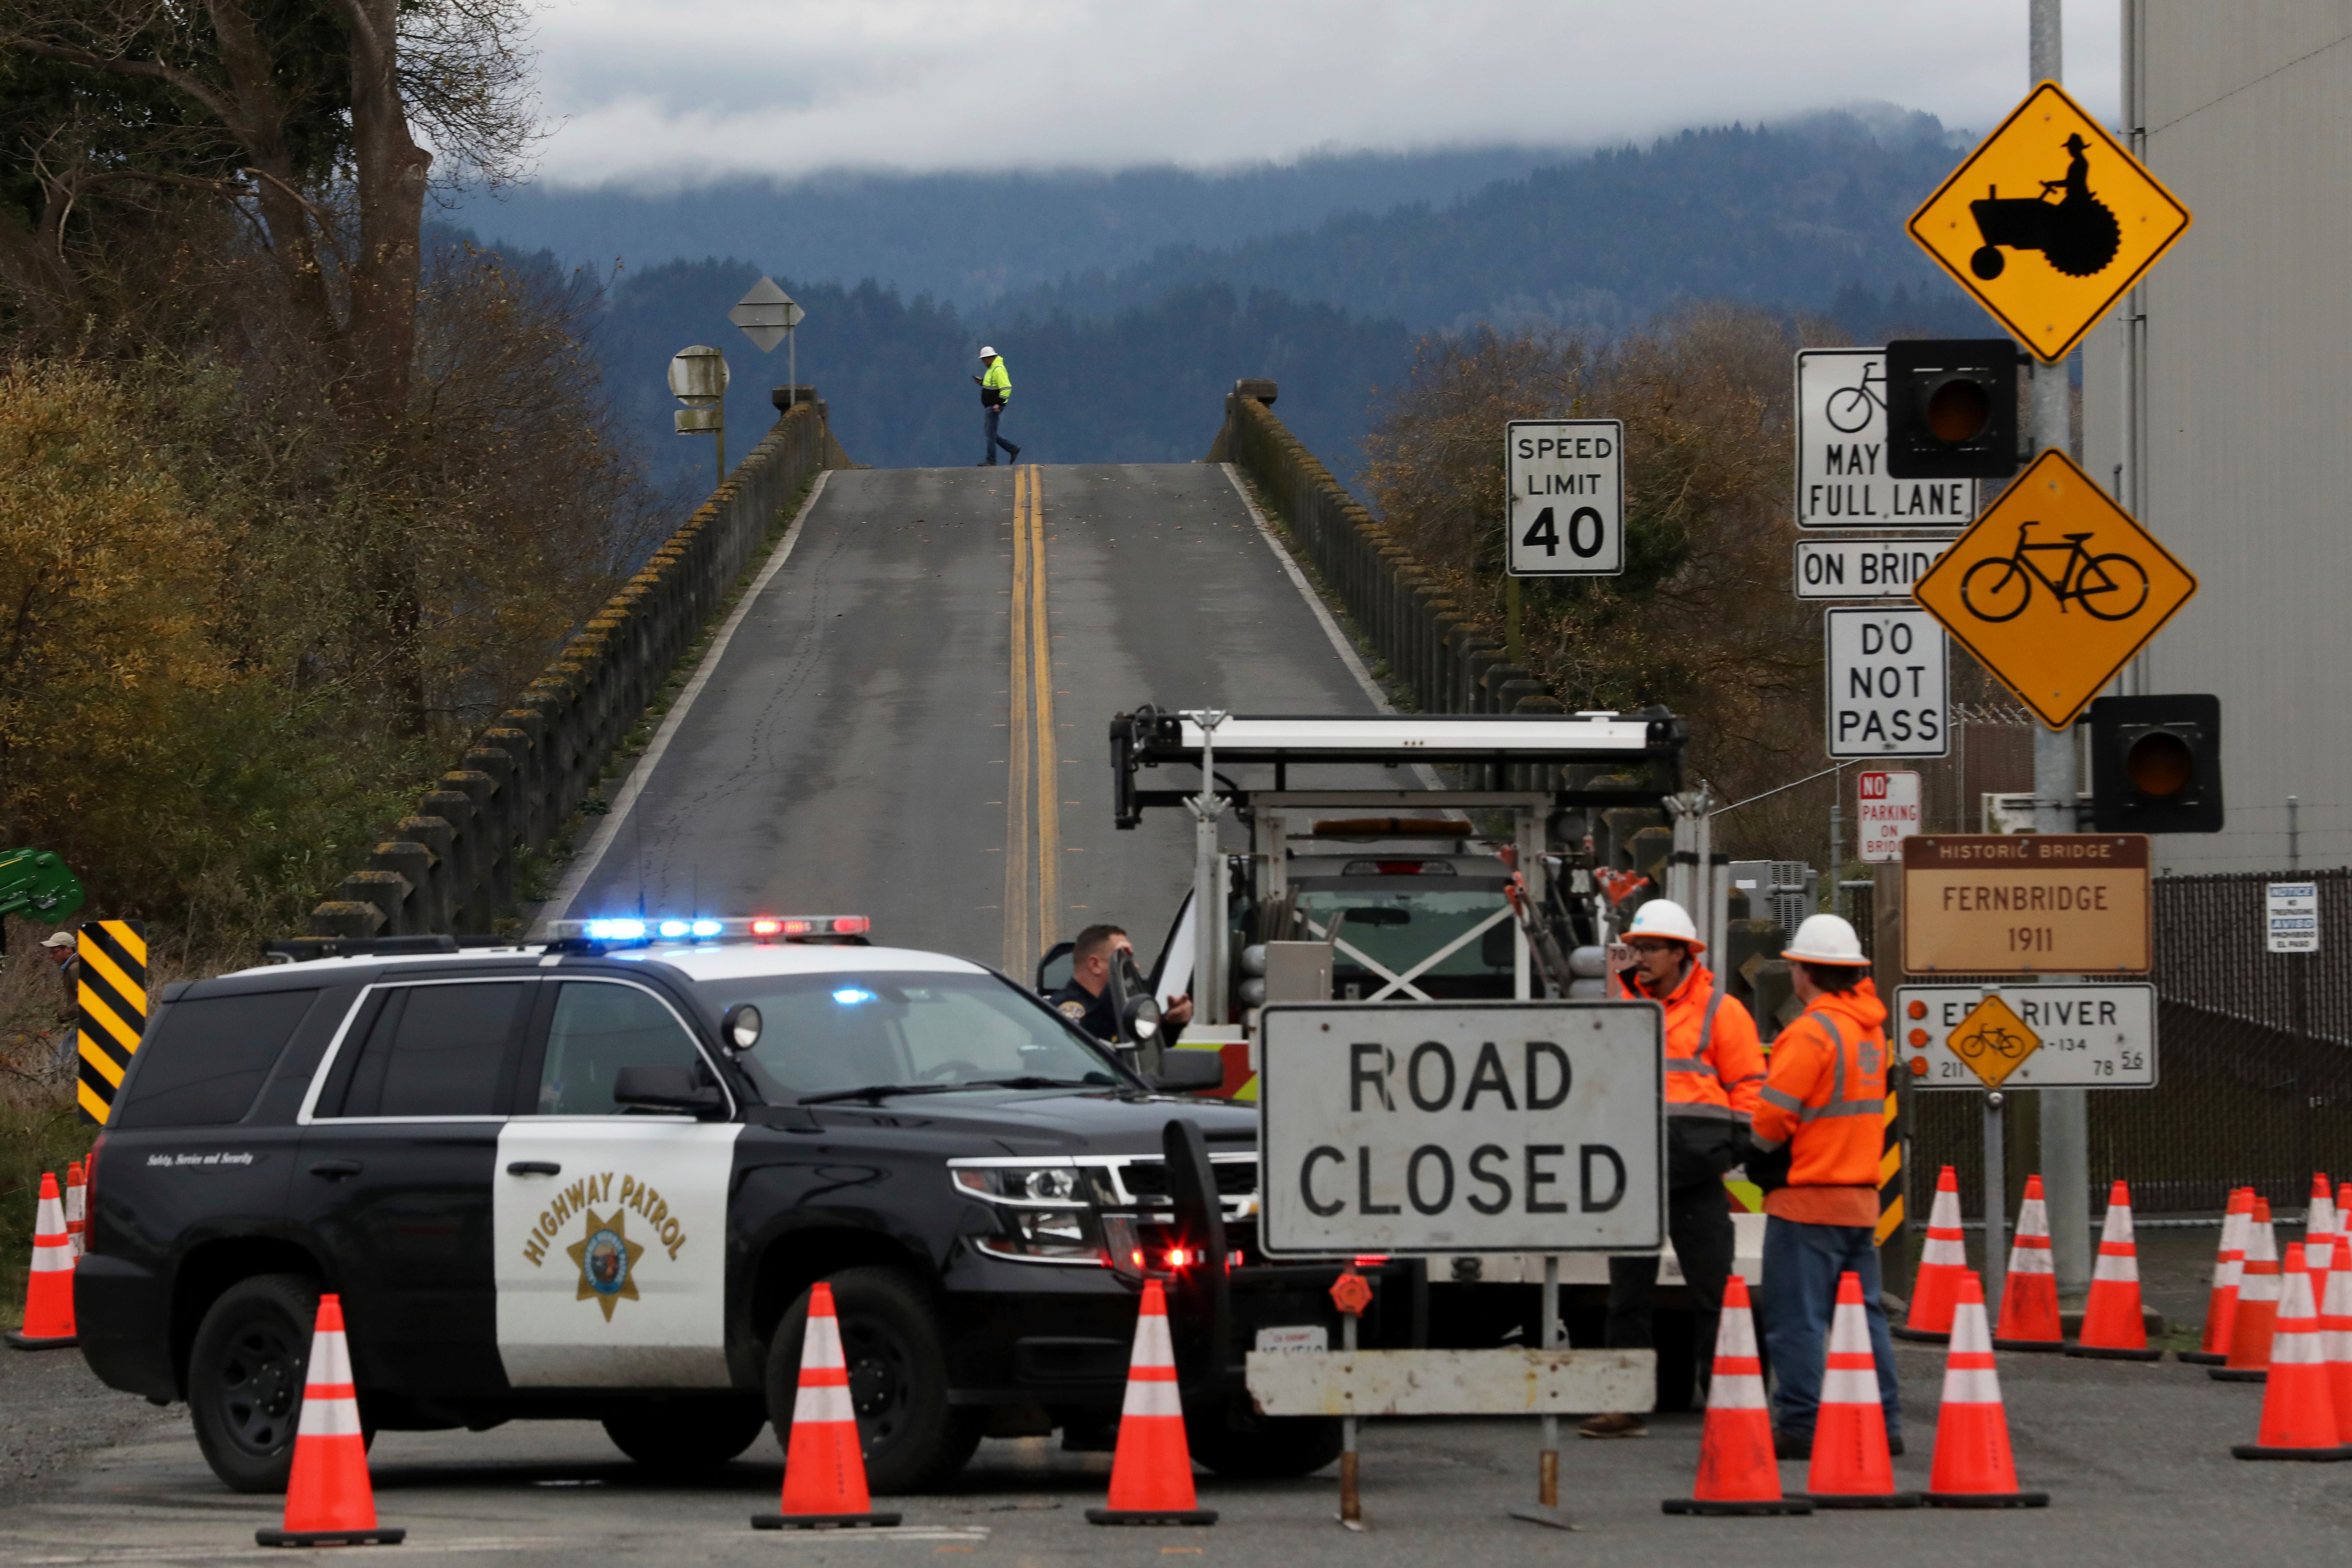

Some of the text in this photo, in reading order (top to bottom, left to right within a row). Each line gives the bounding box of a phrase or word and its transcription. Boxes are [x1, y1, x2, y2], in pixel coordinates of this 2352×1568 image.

[1518, 438, 1611, 459] SPEED
[1826, 443, 1880, 475] MAY
[1528, 474, 1601, 495] LIMIT
[1810, 484, 1963, 516] FULL LANE
[1523, 507, 1604, 558] 40
[1805, 552, 1944, 584] ON BRID
[1862, 623, 1912, 654] DO
[1851, 666, 1924, 698] NOT
[1840, 709, 1937, 742] PASS
[1863, 776, 1884, 796] NO
[1863, 805, 1917, 821] PARKING
[1881, 825, 1898, 837] ON
[1939, 844, 2111, 858] HISTORIC BRIDGE
[1943, 886, 2108, 911] FERNBRIDGE
[2009, 927, 2053, 951] 1911
[2023, 1001, 2116, 1026] RIVER
[2093, 1060, 2114, 1075] 78
[2122, 1051, 2143, 1068] 56
[1350, 1041, 1572, 1112] ROAD
[175, 1153, 203, 1165] Service
[203, 1153, 220, 1164] and
[221, 1152, 254, 1165] Security
[1300, 1144, 1627, 1216] CLOSED
[523, 1172, 613, 1267] HIGHWAY
[620, 1174, 686, 1261] PATROL
